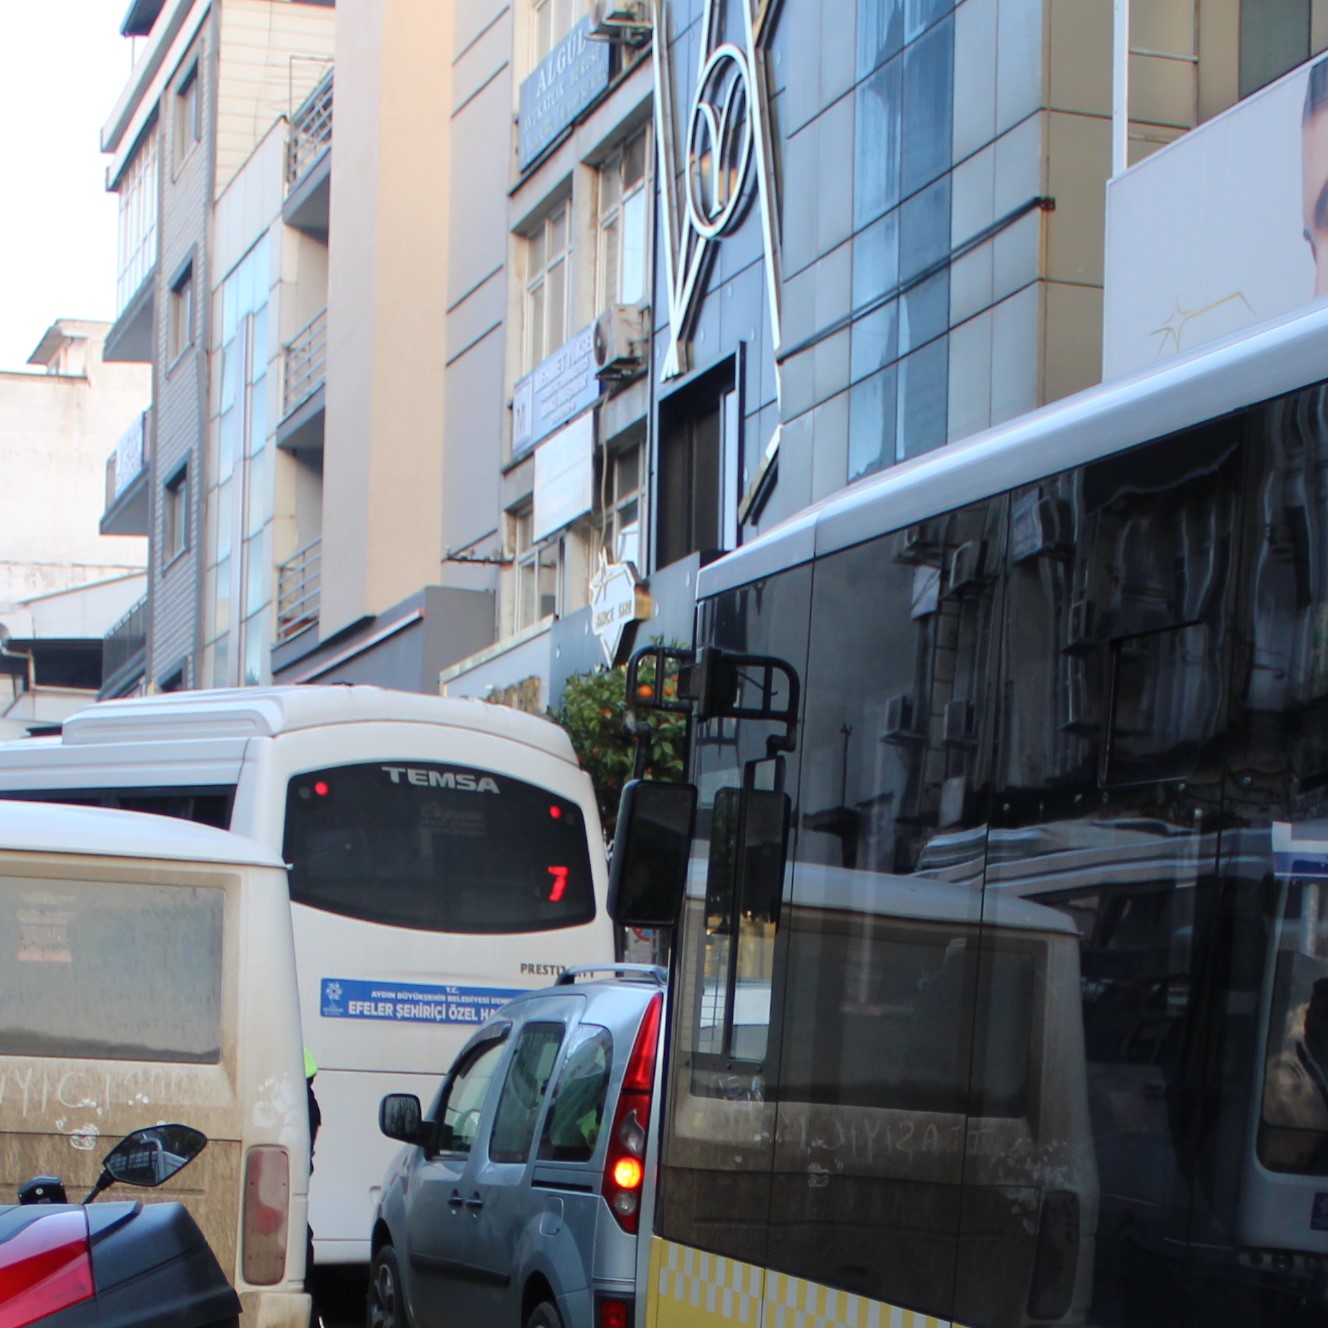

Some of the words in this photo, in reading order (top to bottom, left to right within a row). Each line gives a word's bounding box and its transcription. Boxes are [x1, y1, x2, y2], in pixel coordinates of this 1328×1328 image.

[382, 766, 500, 794] TEMSA
[547, 866, 569, 902] 7
[371, 990, 395, 999] AYDIN
[397, 991, 446, 1002] BÜYÜKŞEHİR
[447, 993, 490, 1004] BELEDİYESİ
[348, 1000, 393, 1016] EFELER
[396, 1001, 446, 1021] ŞEHİRİÇİ
[448, 1004, 478, 1021] ÖZEL
